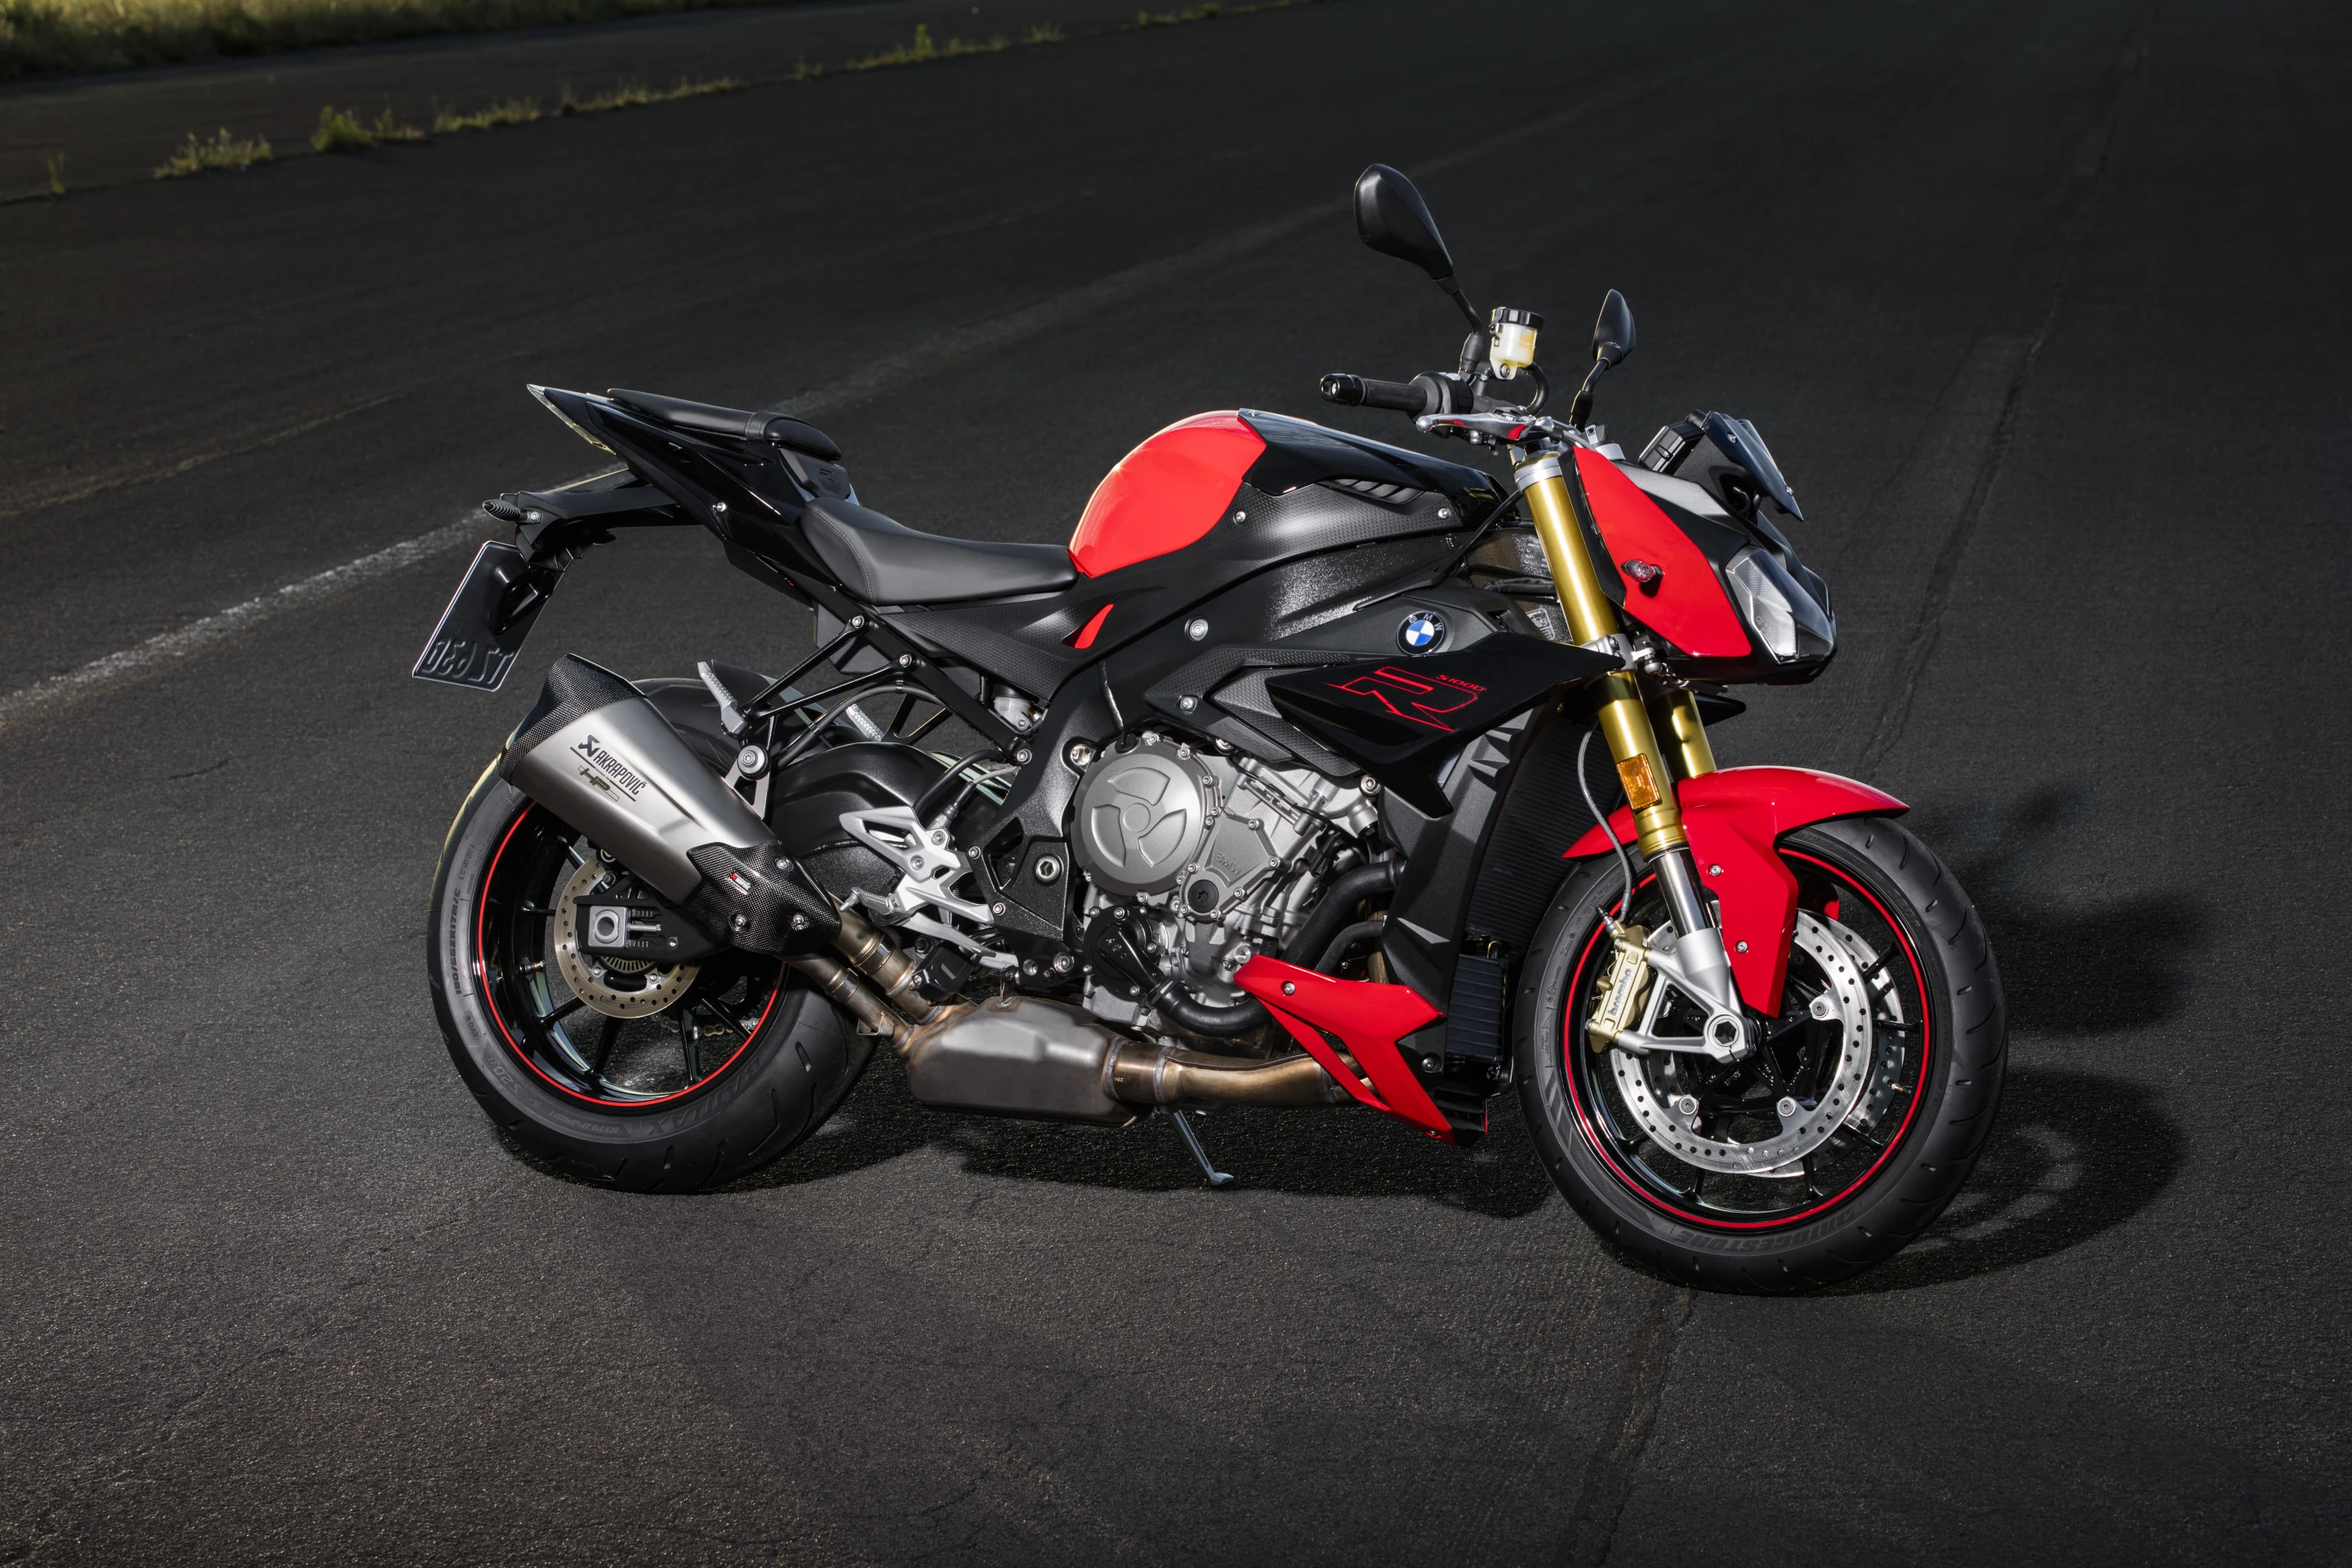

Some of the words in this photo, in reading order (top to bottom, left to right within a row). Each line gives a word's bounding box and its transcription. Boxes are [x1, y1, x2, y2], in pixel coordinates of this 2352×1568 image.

[579, 768, 611, 792] HP
[1215, 852, 1243, 876] BMW
[1607, 968, 1632, 1017] brembo
[1674, 1204, 1855, 1253] BRIDGESTONE
